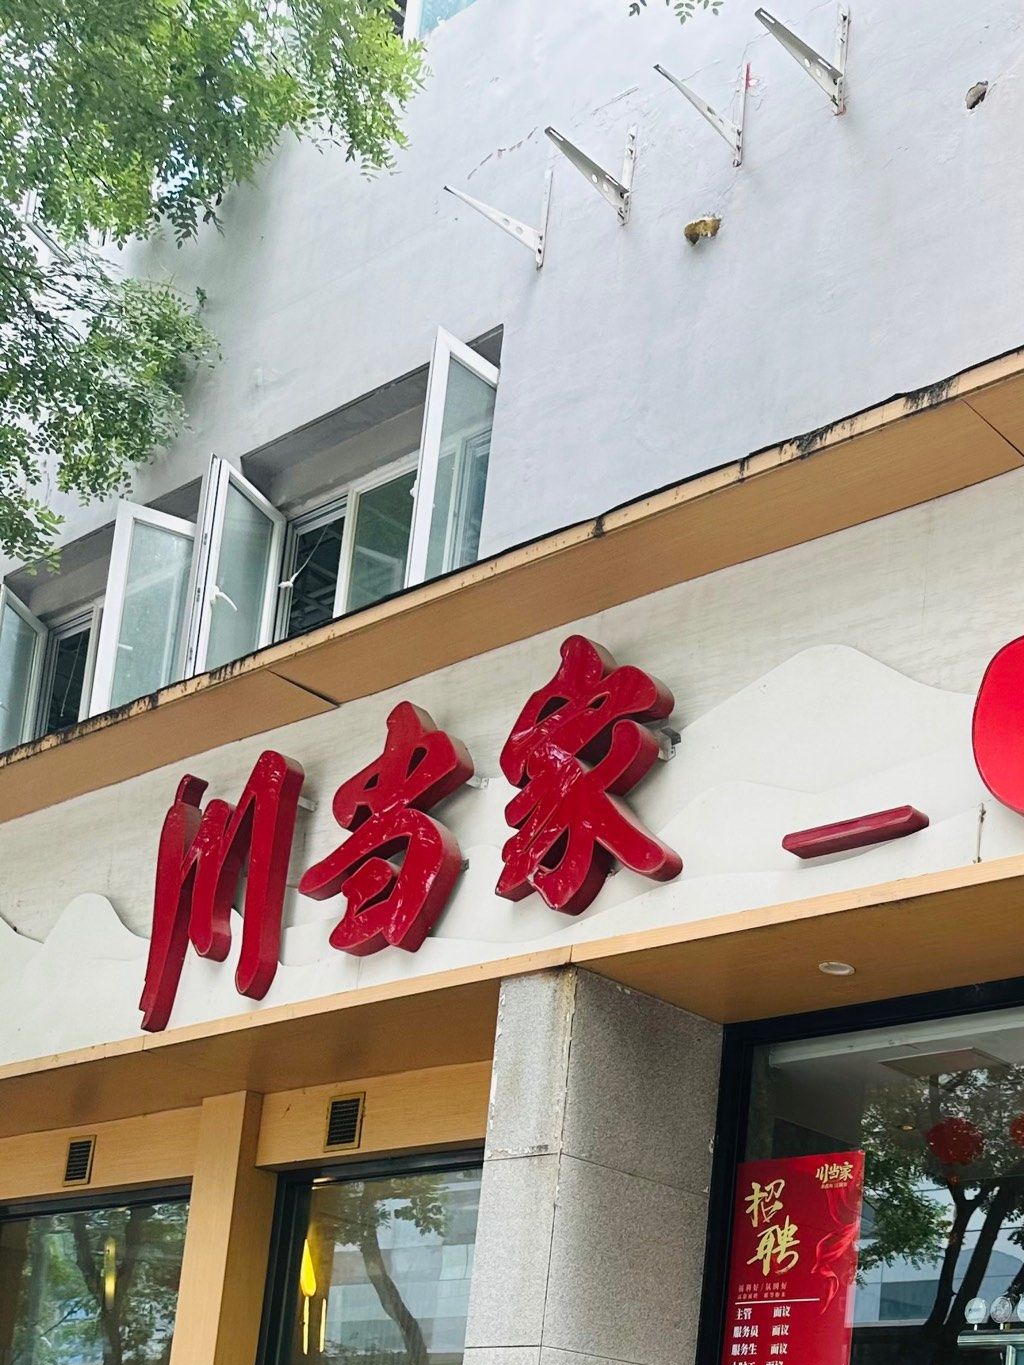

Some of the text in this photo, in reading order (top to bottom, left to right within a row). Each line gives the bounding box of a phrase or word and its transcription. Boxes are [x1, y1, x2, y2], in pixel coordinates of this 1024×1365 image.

[140, 634, 683, 1032] 川当家
[815, 1161, 853, 1184] 川当家
[745, 1178, 800, 1276] 招聘
[735, 1306, 791, 1320] 主管 面议
[733, 1325, 789, 1338] 服务员 面议
[731, 1343, 788, 1356] 服务生 面议
